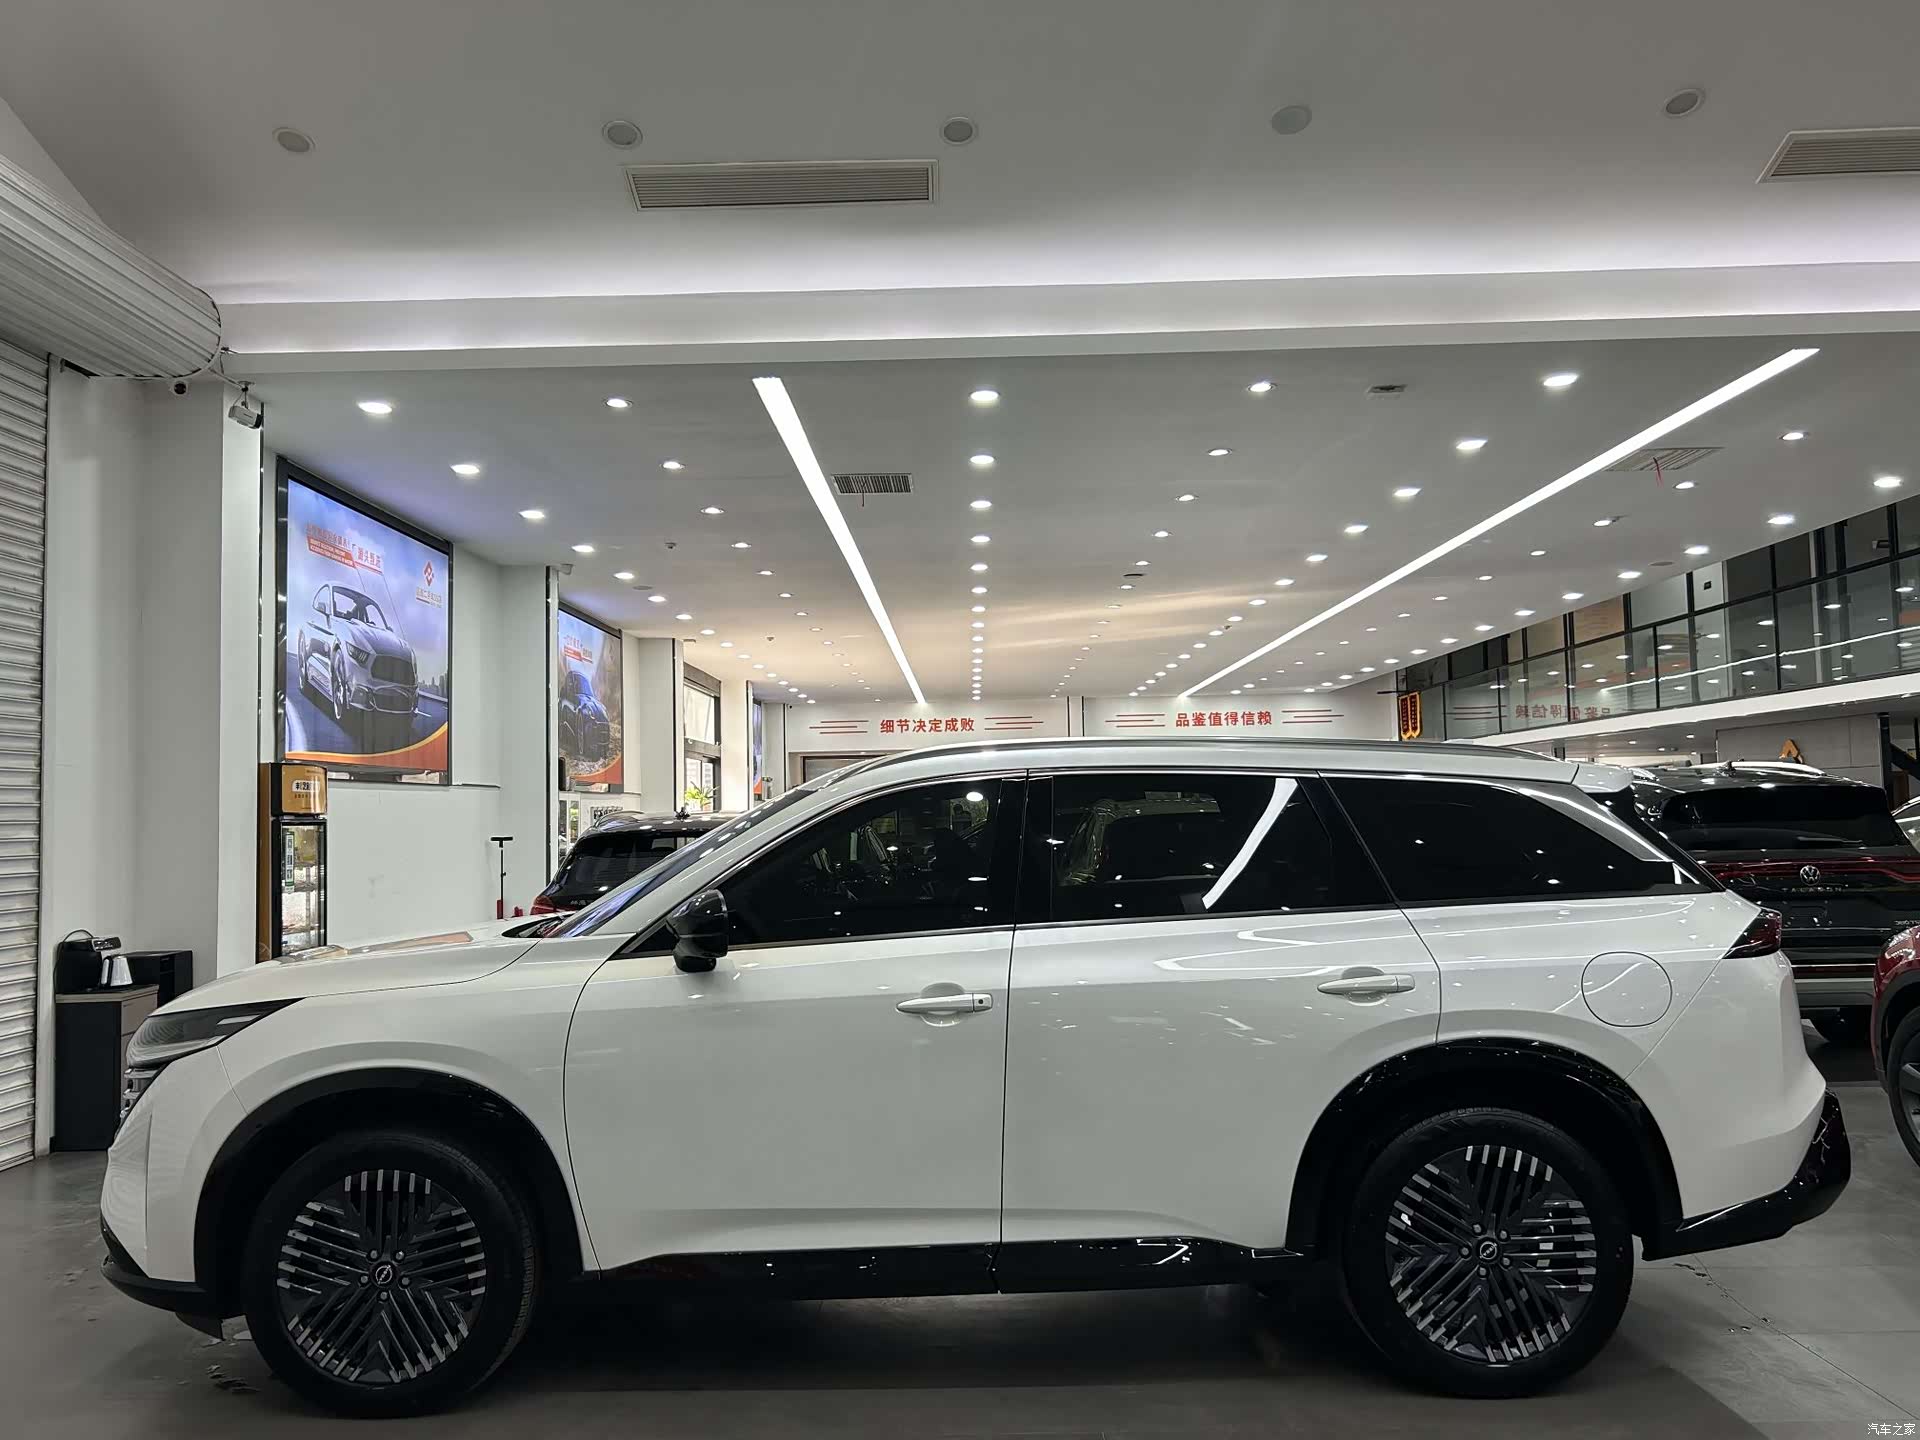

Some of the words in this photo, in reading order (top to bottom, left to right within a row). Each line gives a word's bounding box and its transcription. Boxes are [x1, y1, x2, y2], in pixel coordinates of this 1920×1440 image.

[880, 718, 975, 733] 细节决定成败
[1175, 711, 1272, 727] 品鉴值得信赖
